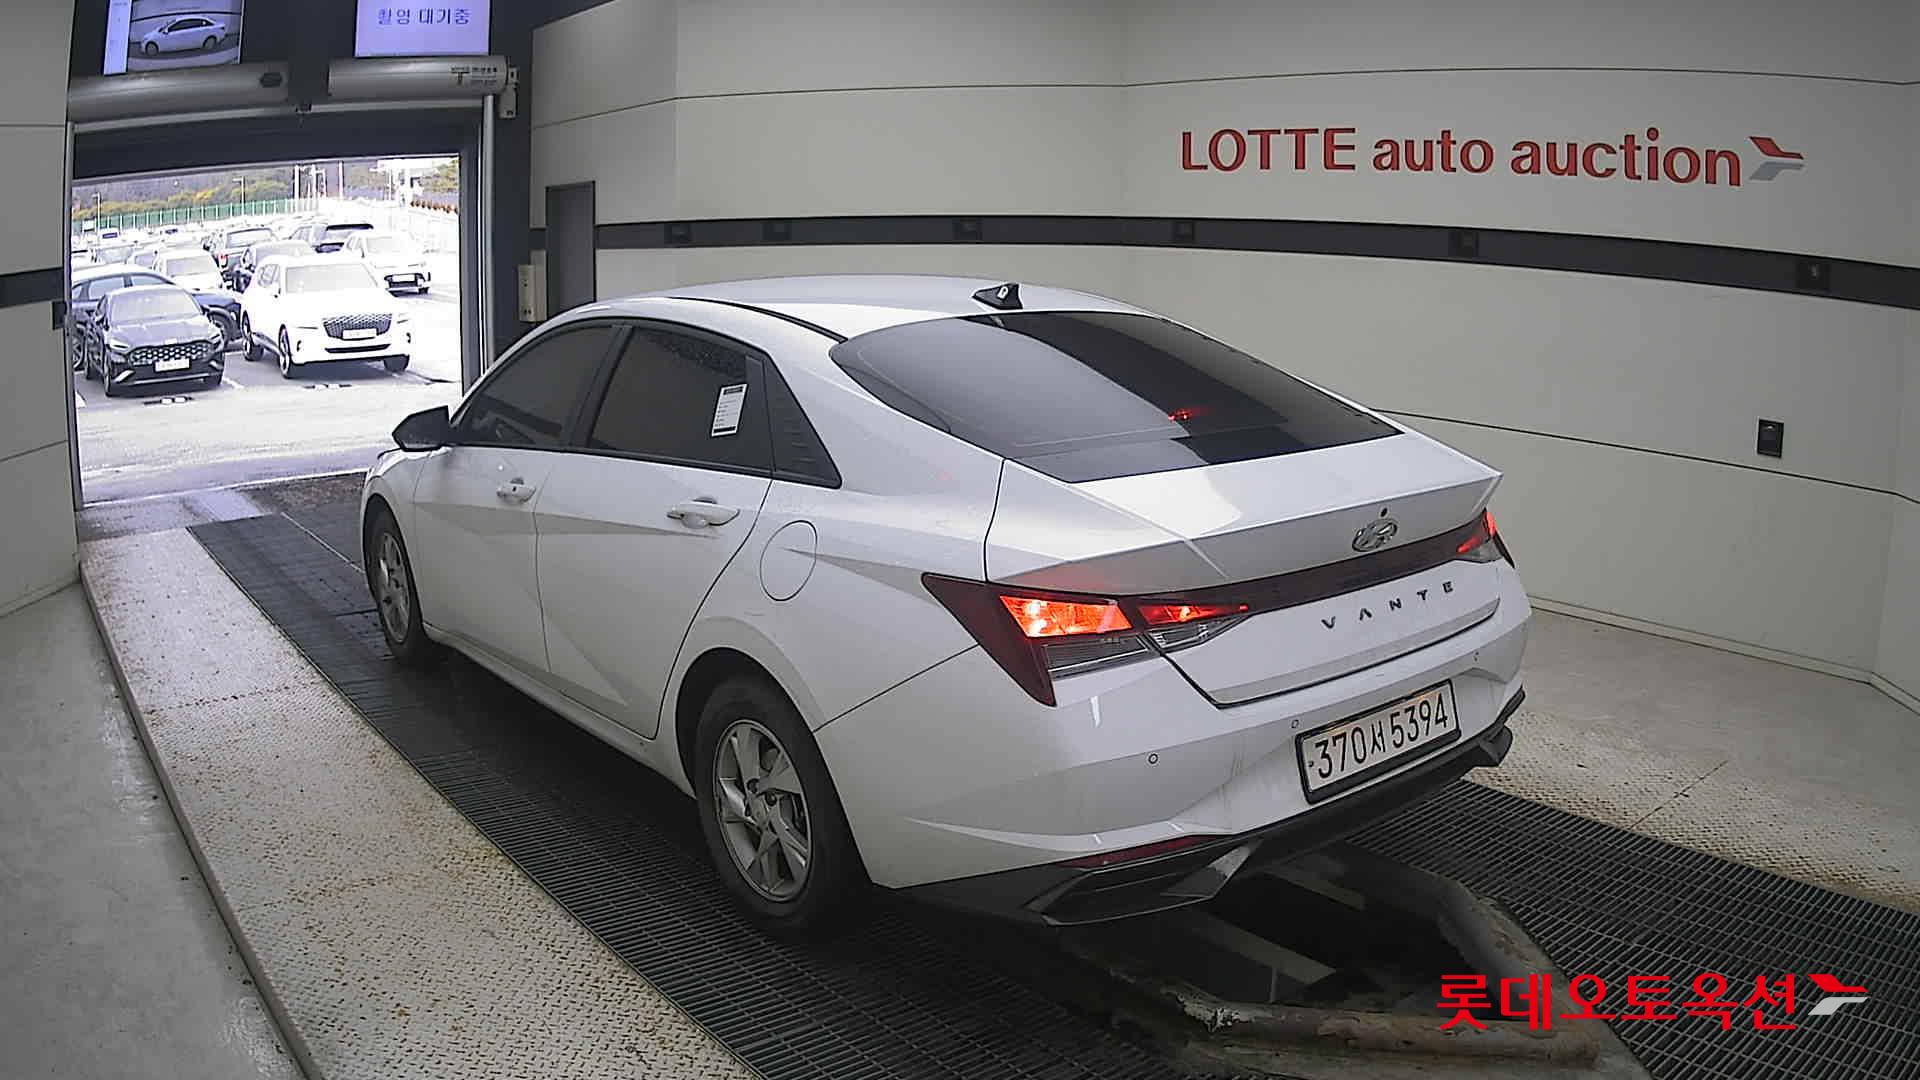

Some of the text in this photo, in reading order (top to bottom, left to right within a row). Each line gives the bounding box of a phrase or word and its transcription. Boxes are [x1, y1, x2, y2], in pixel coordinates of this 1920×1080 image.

[419, 7, 469, 25] 대기중
[1182, 127, 1740, 187] LOTTE auto auction
